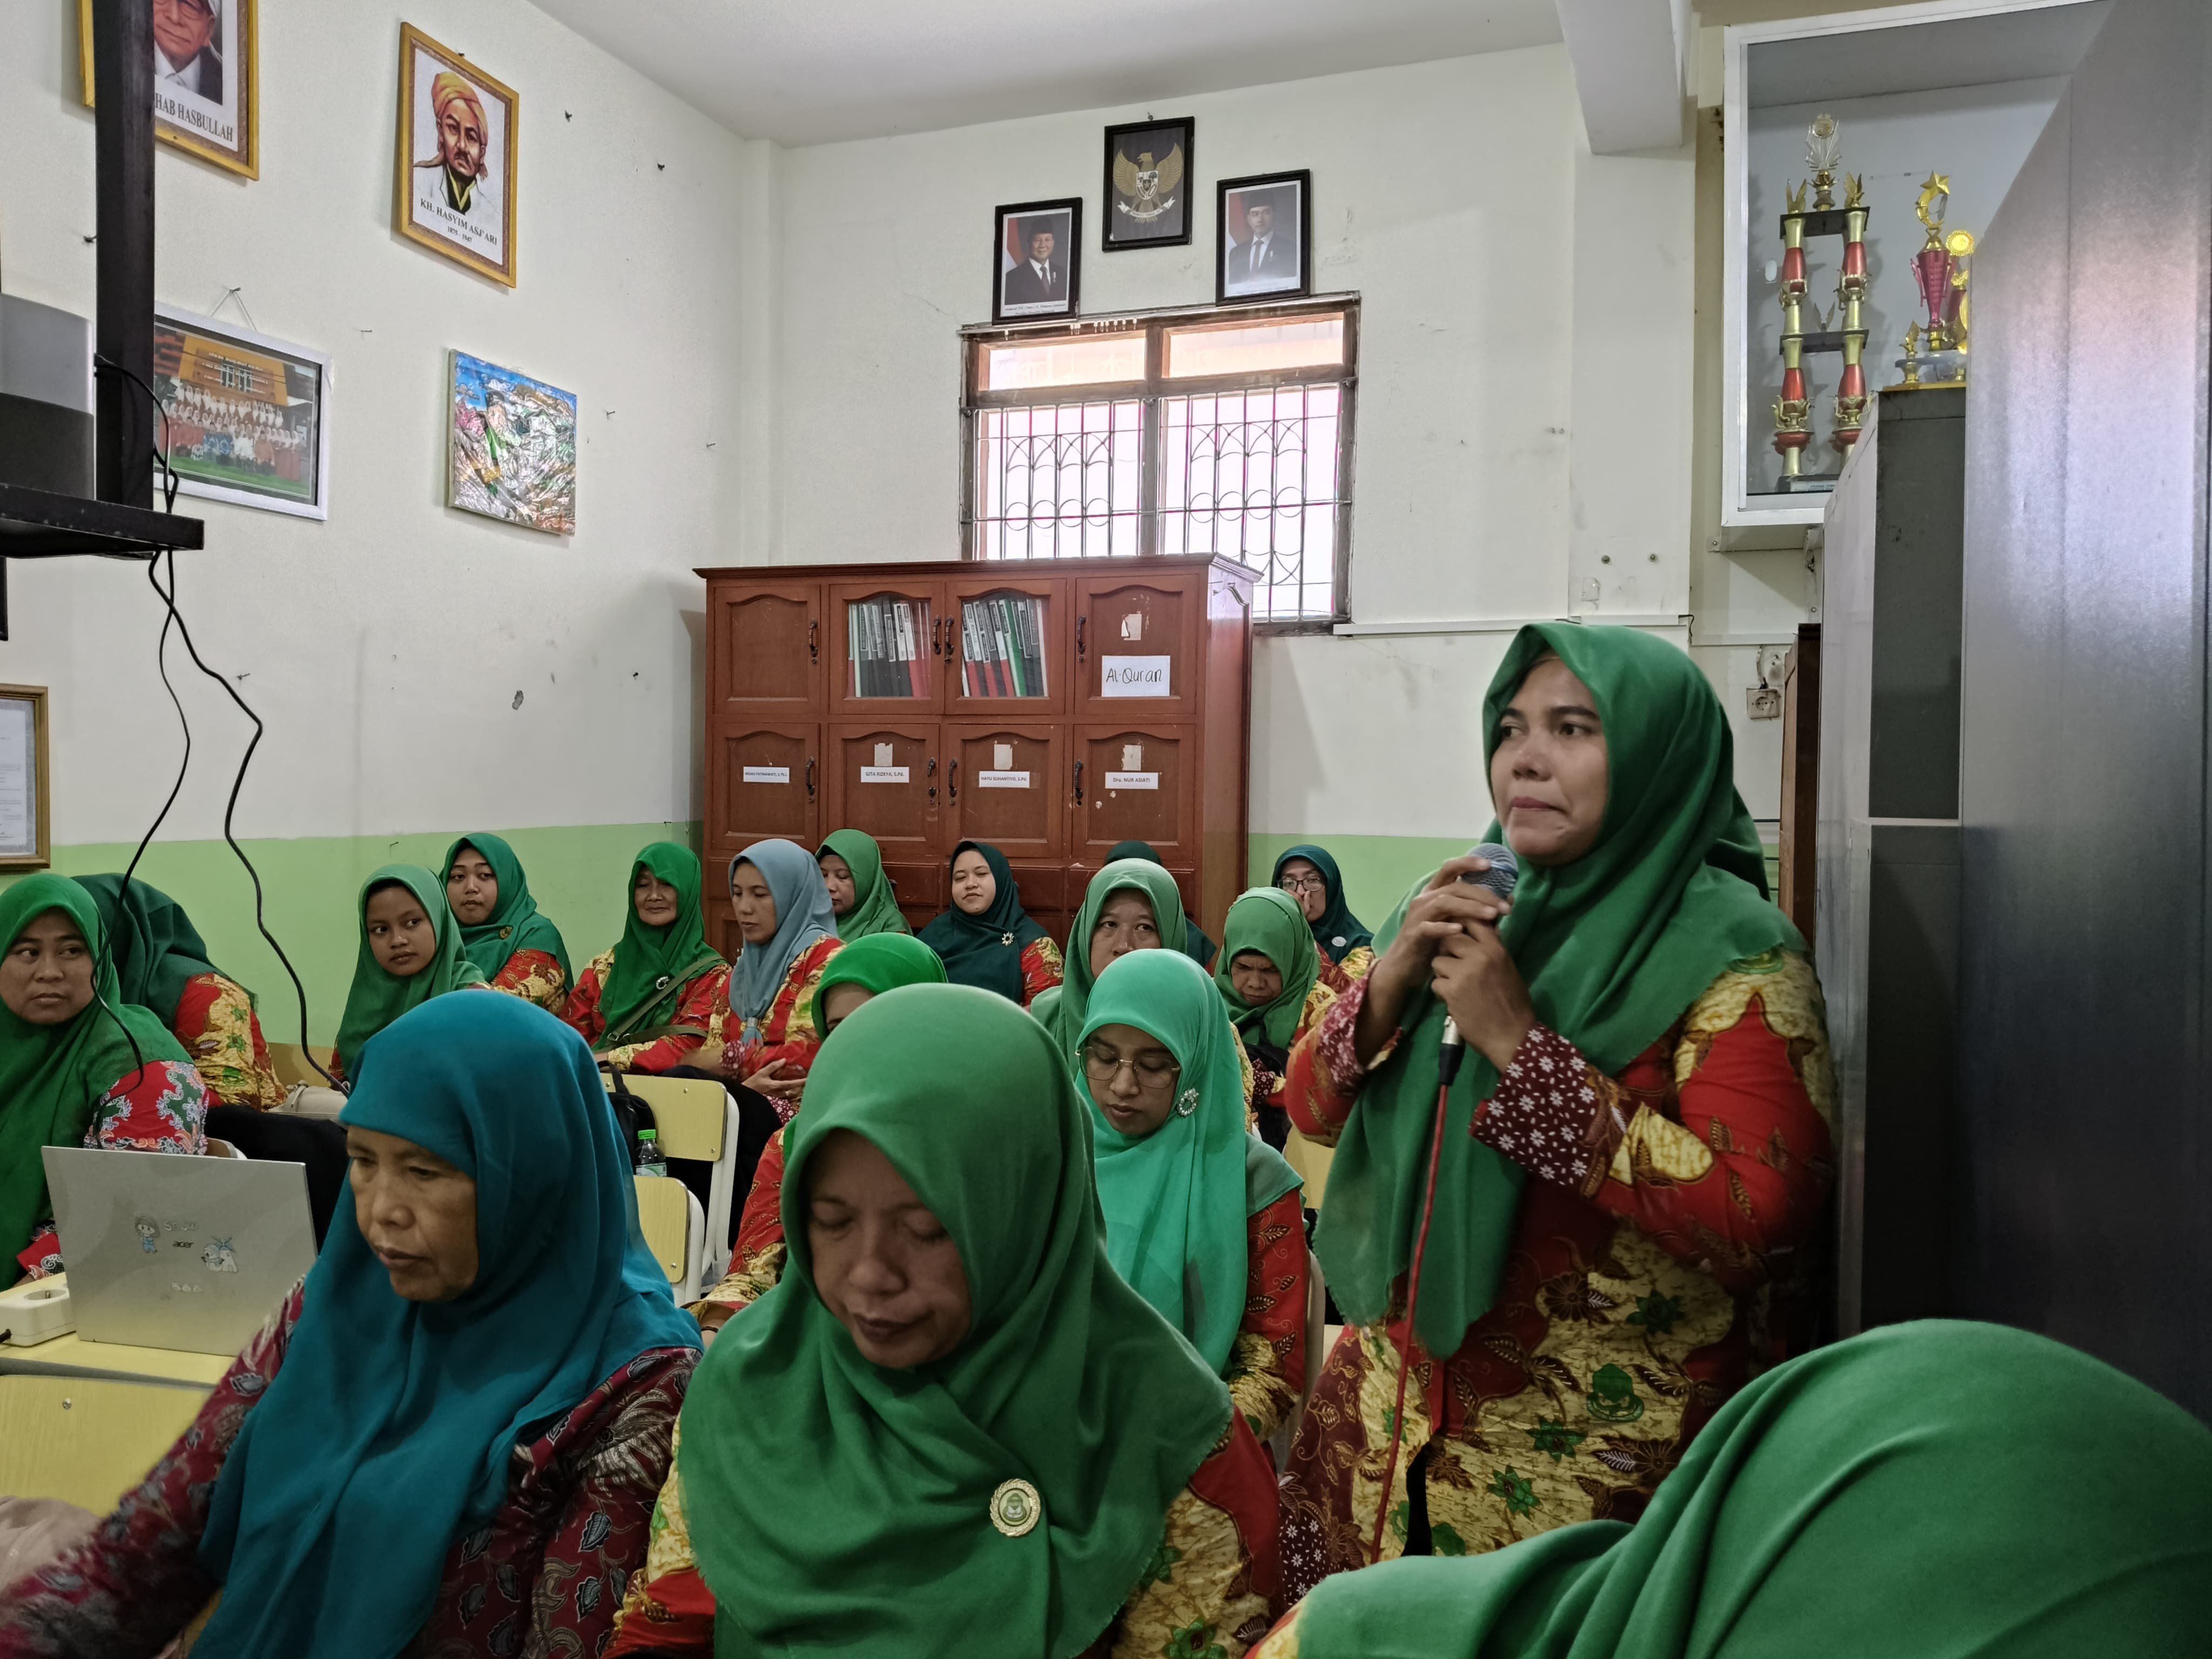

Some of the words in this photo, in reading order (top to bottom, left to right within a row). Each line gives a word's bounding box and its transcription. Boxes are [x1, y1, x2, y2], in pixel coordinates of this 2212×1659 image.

[155, 92, 176, 116] HAB
[178, 103, 233, 142] HASBULLAH
[421, 198, 435, 212] KH.
[436, 206, 468, 230] HASYIM
[447, 226, 458, 236] 1875
